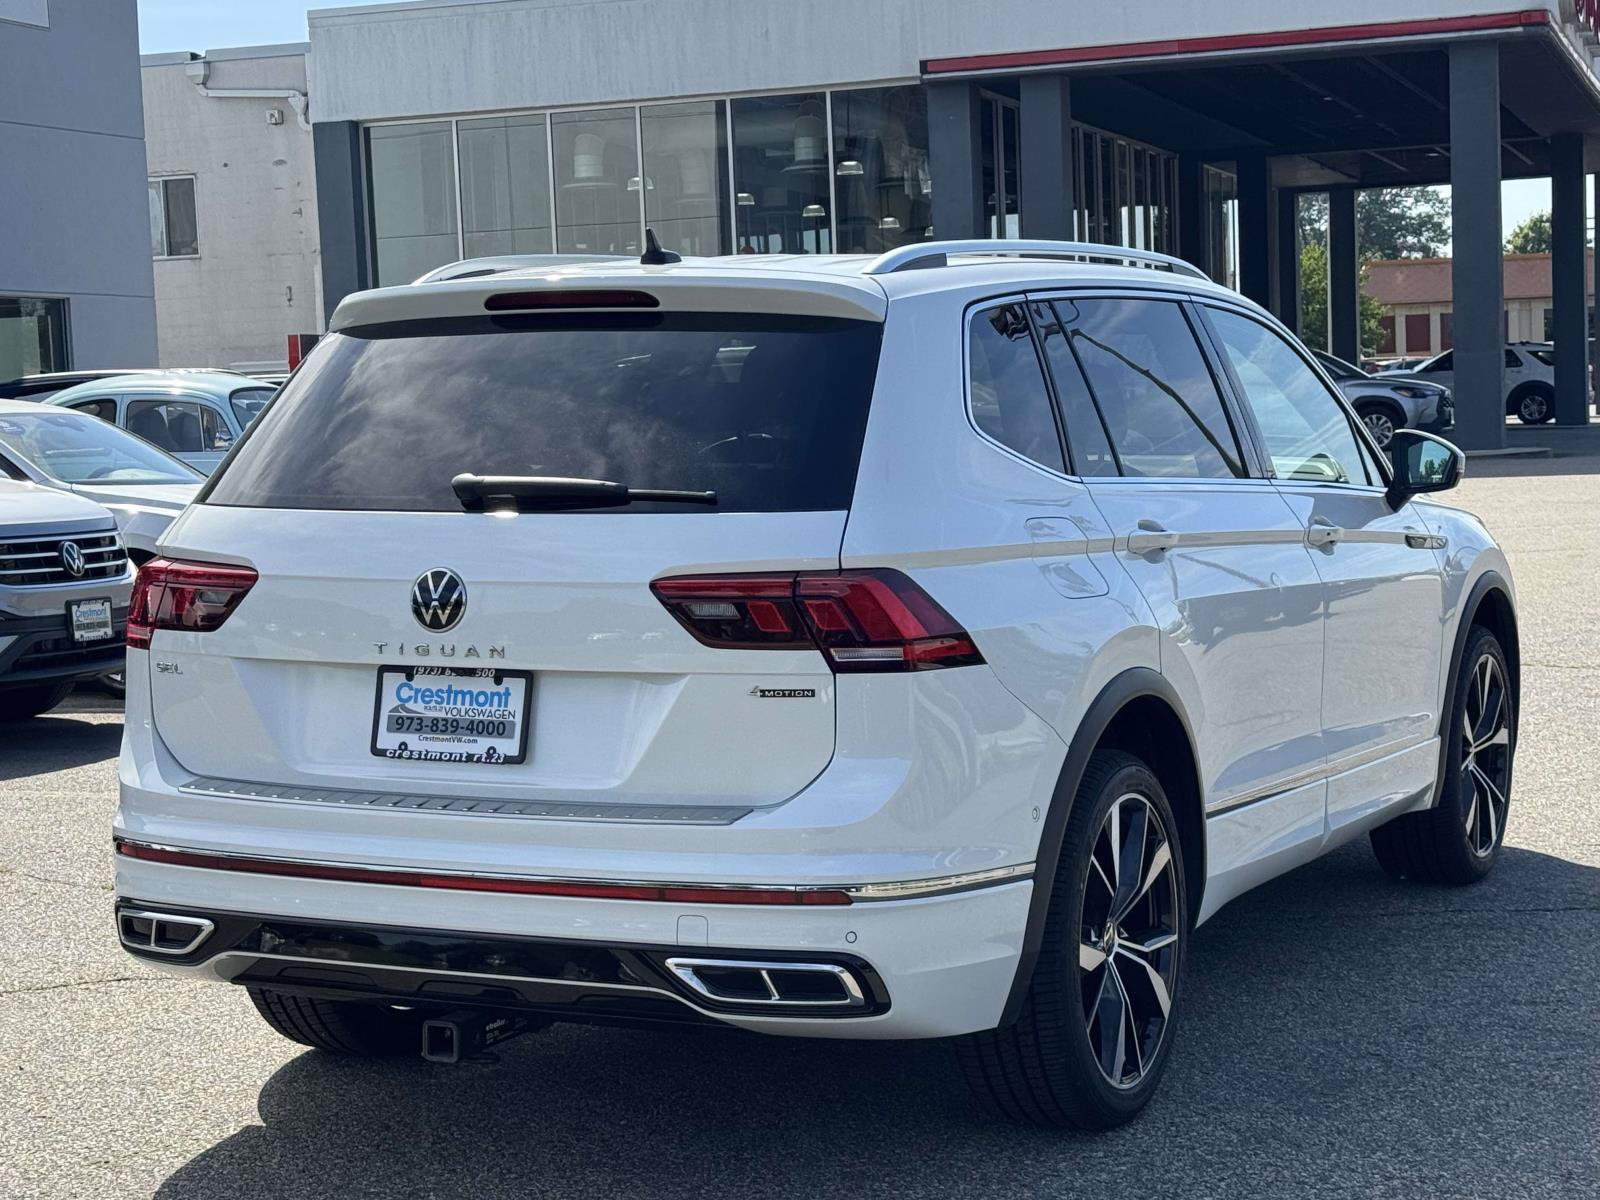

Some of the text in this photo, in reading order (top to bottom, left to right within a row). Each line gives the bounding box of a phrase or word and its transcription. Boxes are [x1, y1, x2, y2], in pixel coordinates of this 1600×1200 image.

[373, 641, 506, 659] TIGUAN
[156, 662, 184, 676] SEL
[395, 682, 512, 708] Crestmont
[746, 685, 813, 697] 4MOTION
[444, 706, 516, 720] VOLKSWAGEN
[395, 716, 506, 736] 973-839-4000
[418, 734, 478, 744] CrestmontVW.com
[386, 748, 467, 762] crestmont
